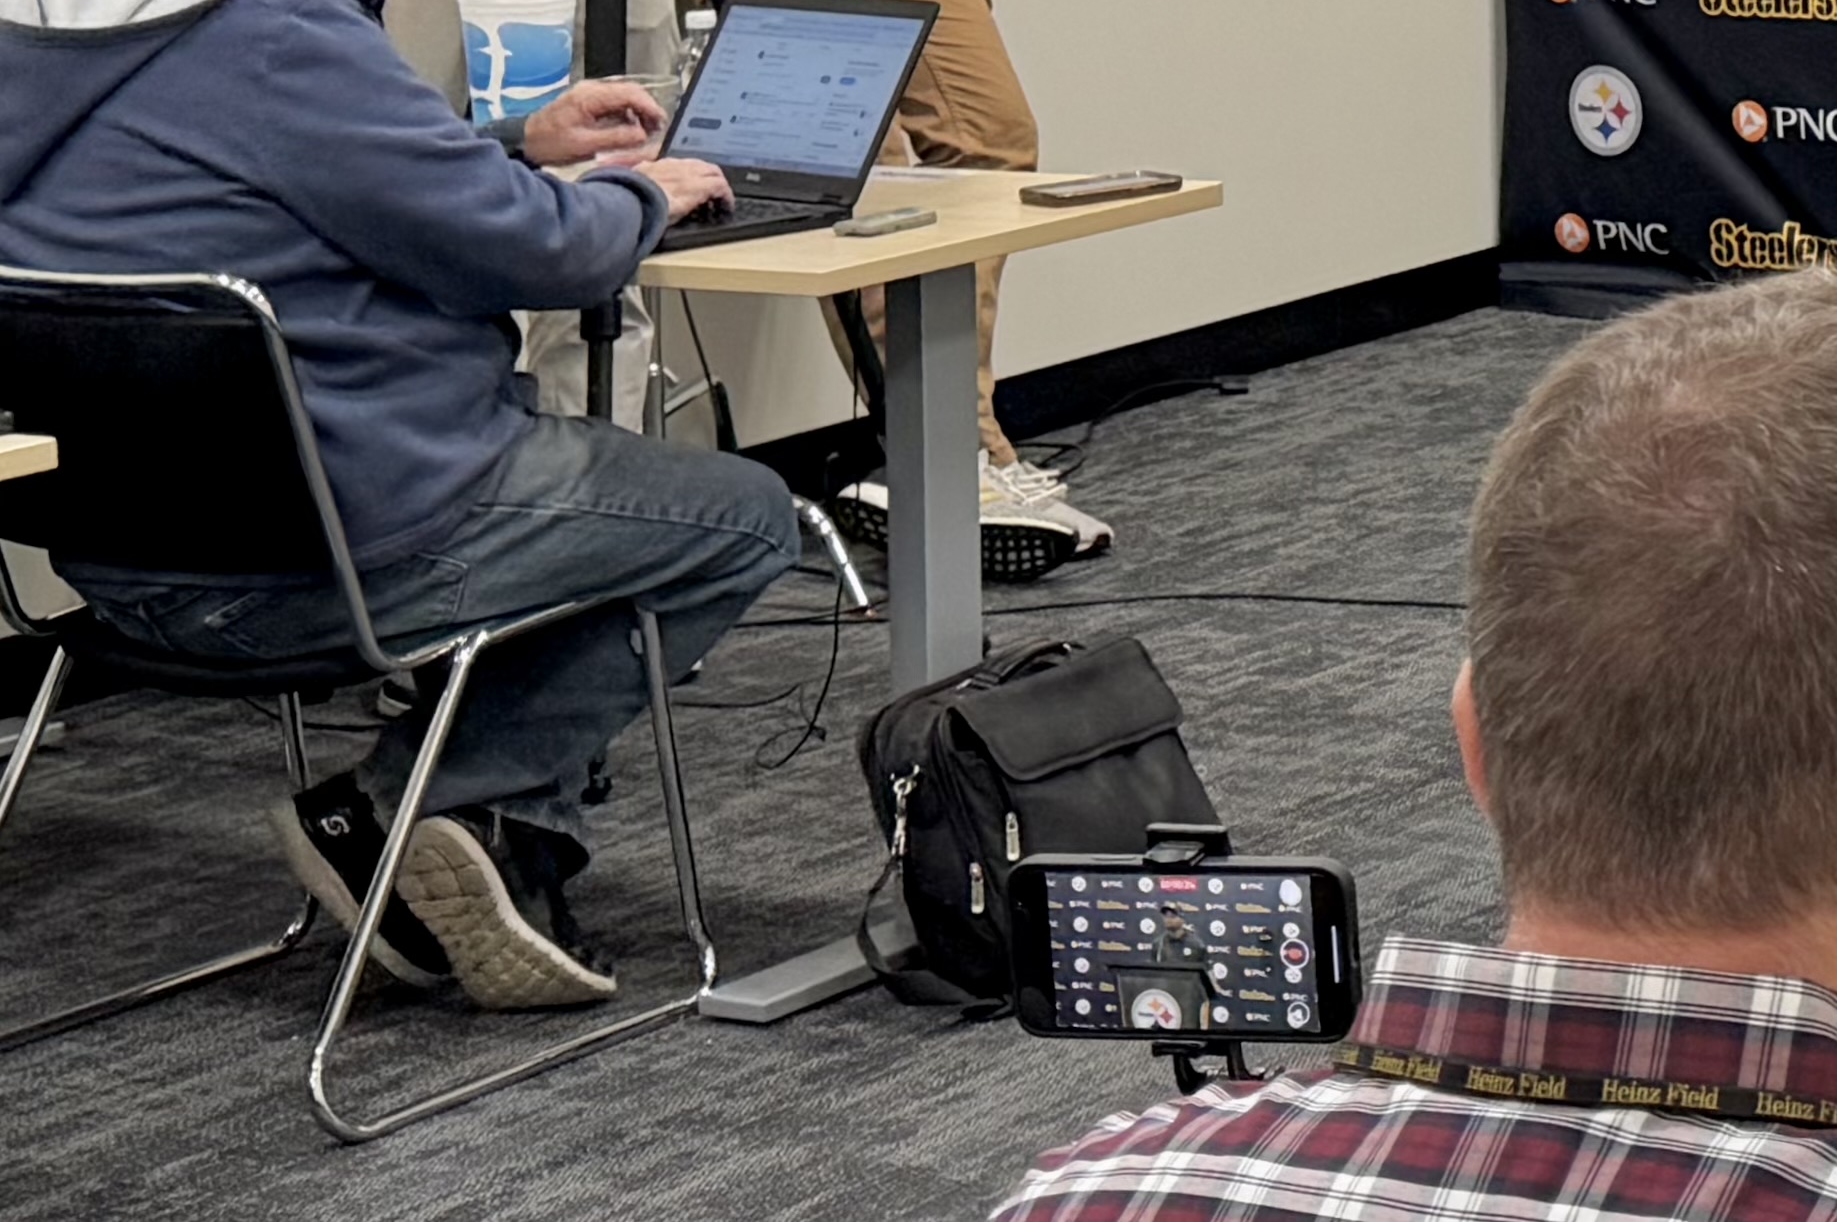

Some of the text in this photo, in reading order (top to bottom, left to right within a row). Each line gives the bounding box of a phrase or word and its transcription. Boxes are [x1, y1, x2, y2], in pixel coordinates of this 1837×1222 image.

[1595, 221, 1666, 250] PNC
[1465, 1065, 1515, 1095] Heinz
[1517, 1072, 1567, 1100] Field
[1602, 1078, 1661, 1104] Heinz
[1665, 1081, 1720, 1111] Field
[1755, 1091, 1815, 1119] Heinz
